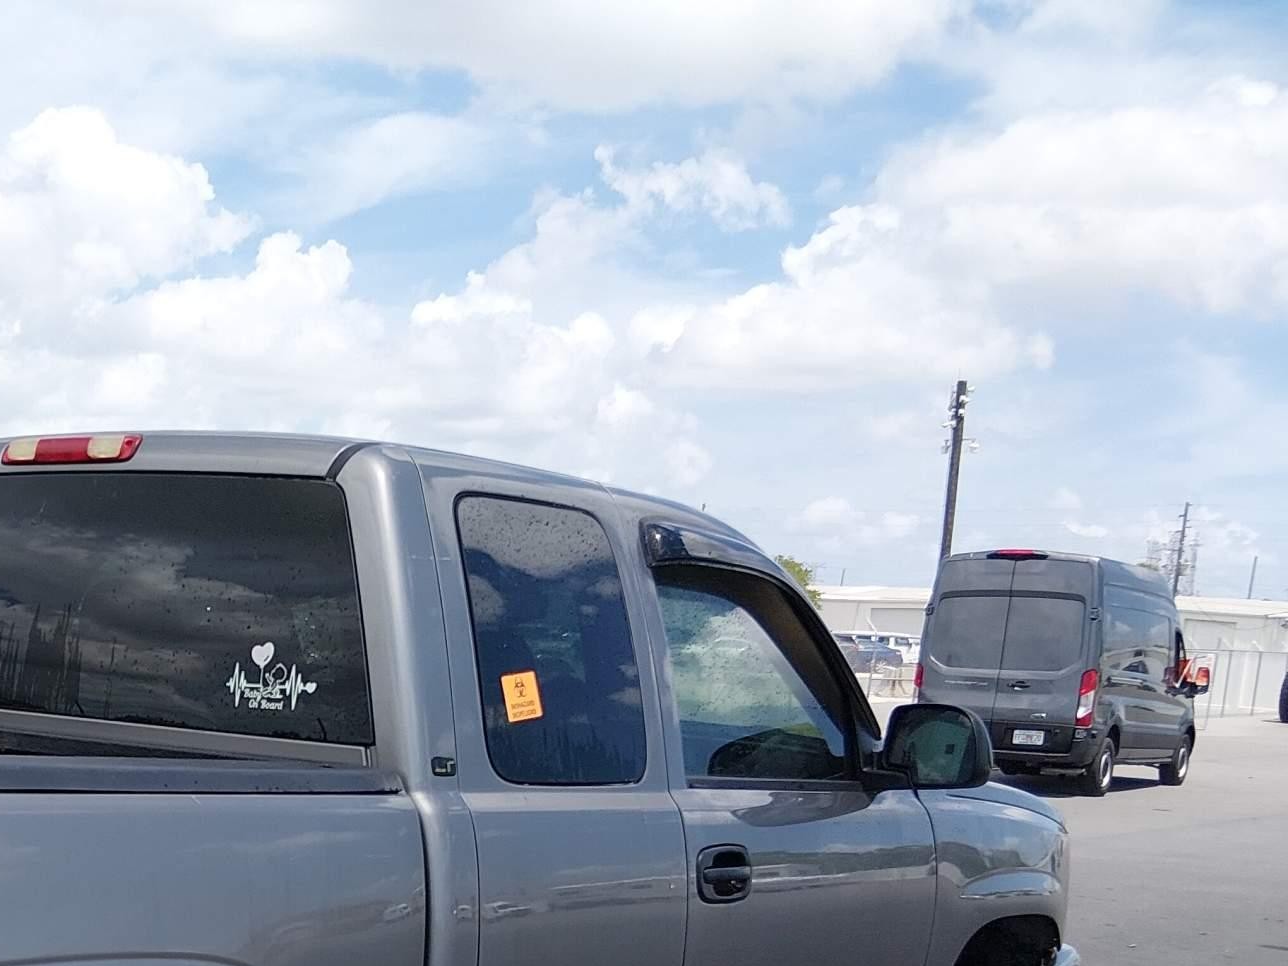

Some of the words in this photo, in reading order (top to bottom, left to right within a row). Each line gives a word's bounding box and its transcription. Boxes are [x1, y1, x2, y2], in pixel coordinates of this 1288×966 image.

[244, 688, 261, 703] Baby
[249, 699, 258, 709] On
[261, 699, 284, 710] Board
